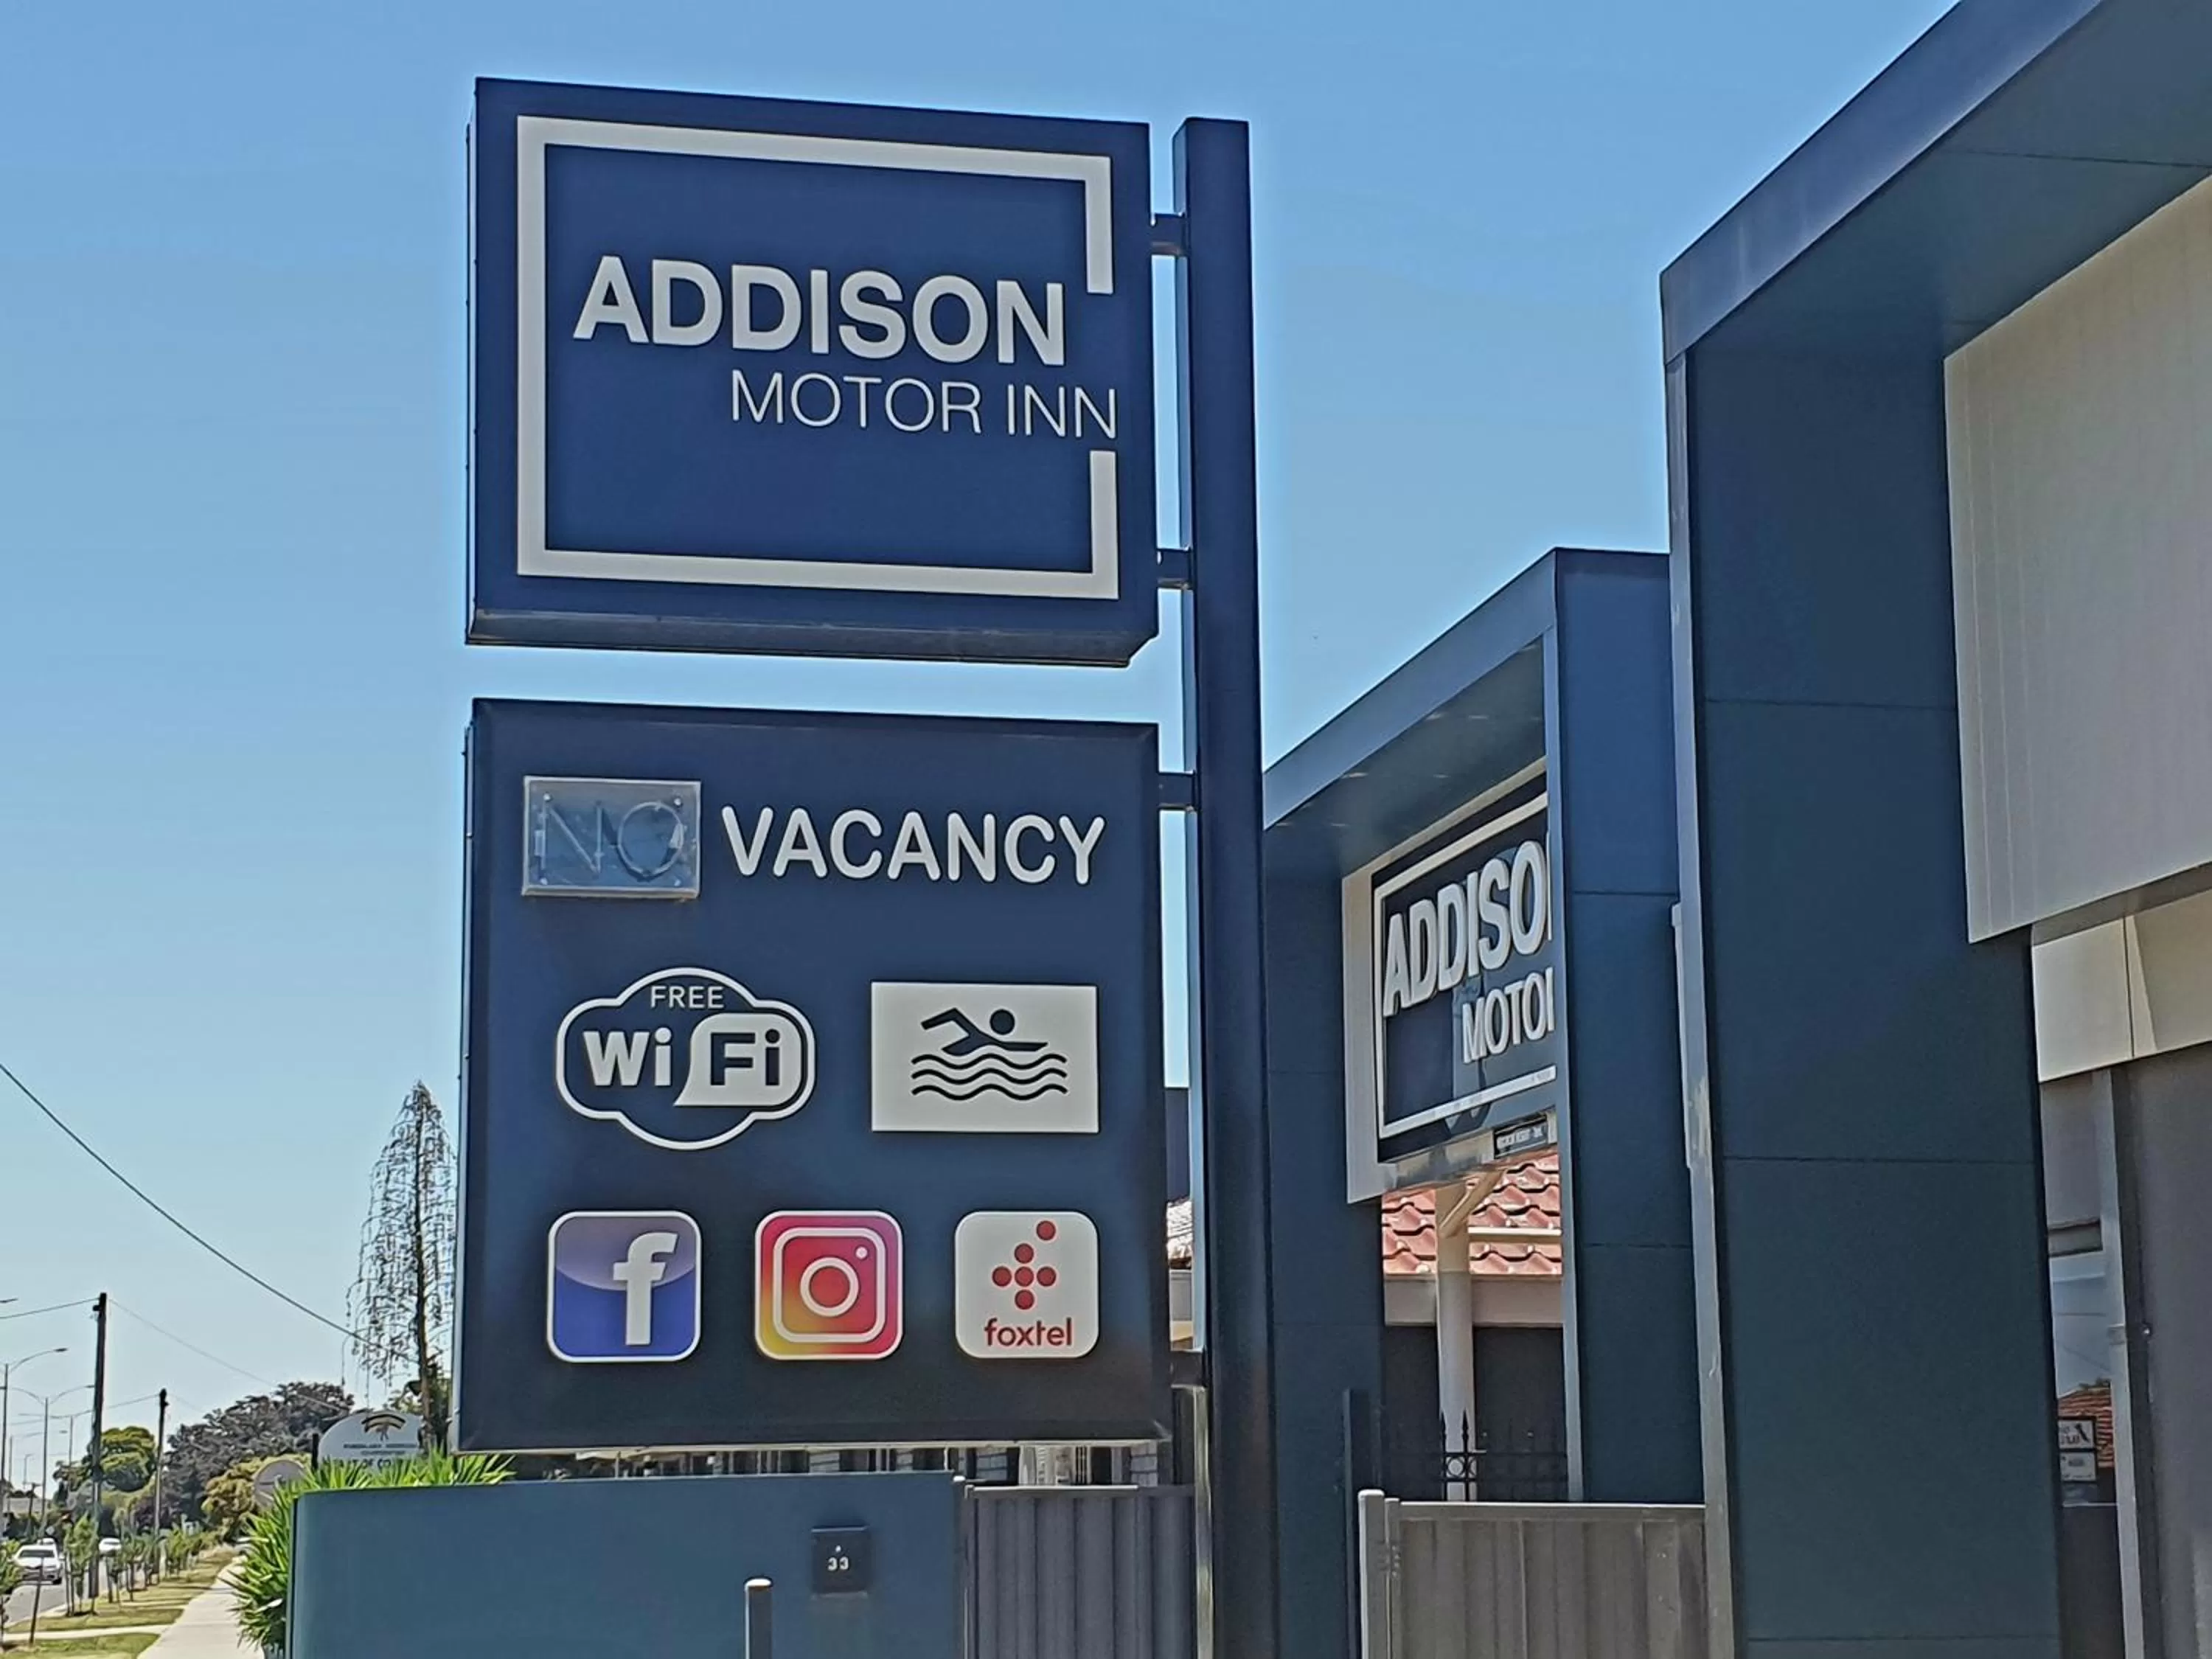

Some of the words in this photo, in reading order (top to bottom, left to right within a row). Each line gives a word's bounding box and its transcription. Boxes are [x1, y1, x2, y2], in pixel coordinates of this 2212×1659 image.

[573, 255, 1064, 366] ADDISON
[732, 369, 981, 434] MOTOR
[1007, 384, 1116, 439] INN
[534, 801, 686, 879] NO
[722, 806, 1105, 885] VACANCY
[1383, 830, 1552, 1018] ADDISO
[650, 985, 724, 1009] FREE
[984, 1317, 1072, 1346] foxtel
[827, 1556, 849, 1572] 33
